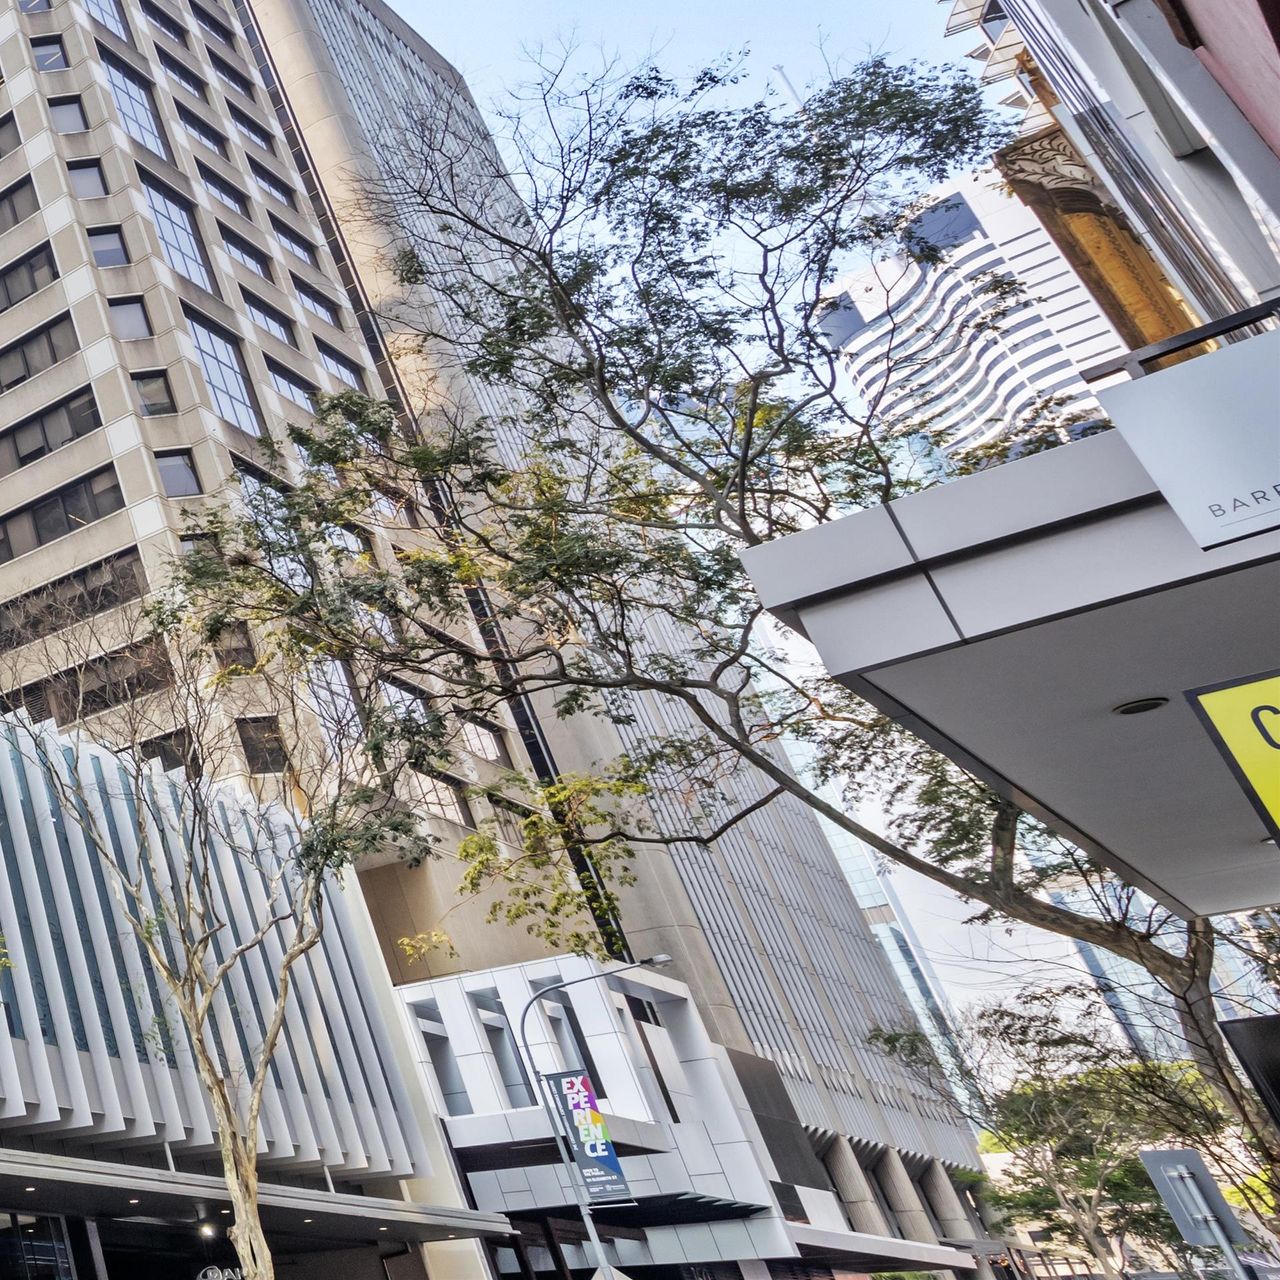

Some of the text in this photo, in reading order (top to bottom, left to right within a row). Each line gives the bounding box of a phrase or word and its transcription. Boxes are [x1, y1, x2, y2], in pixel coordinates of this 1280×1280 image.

[561, 1076, 585, 1094] EX
[567, 1091, 590, 1110] PE
[578, 1124, 603, 1142] EN
[584, 1140, 608, 1157] CE
